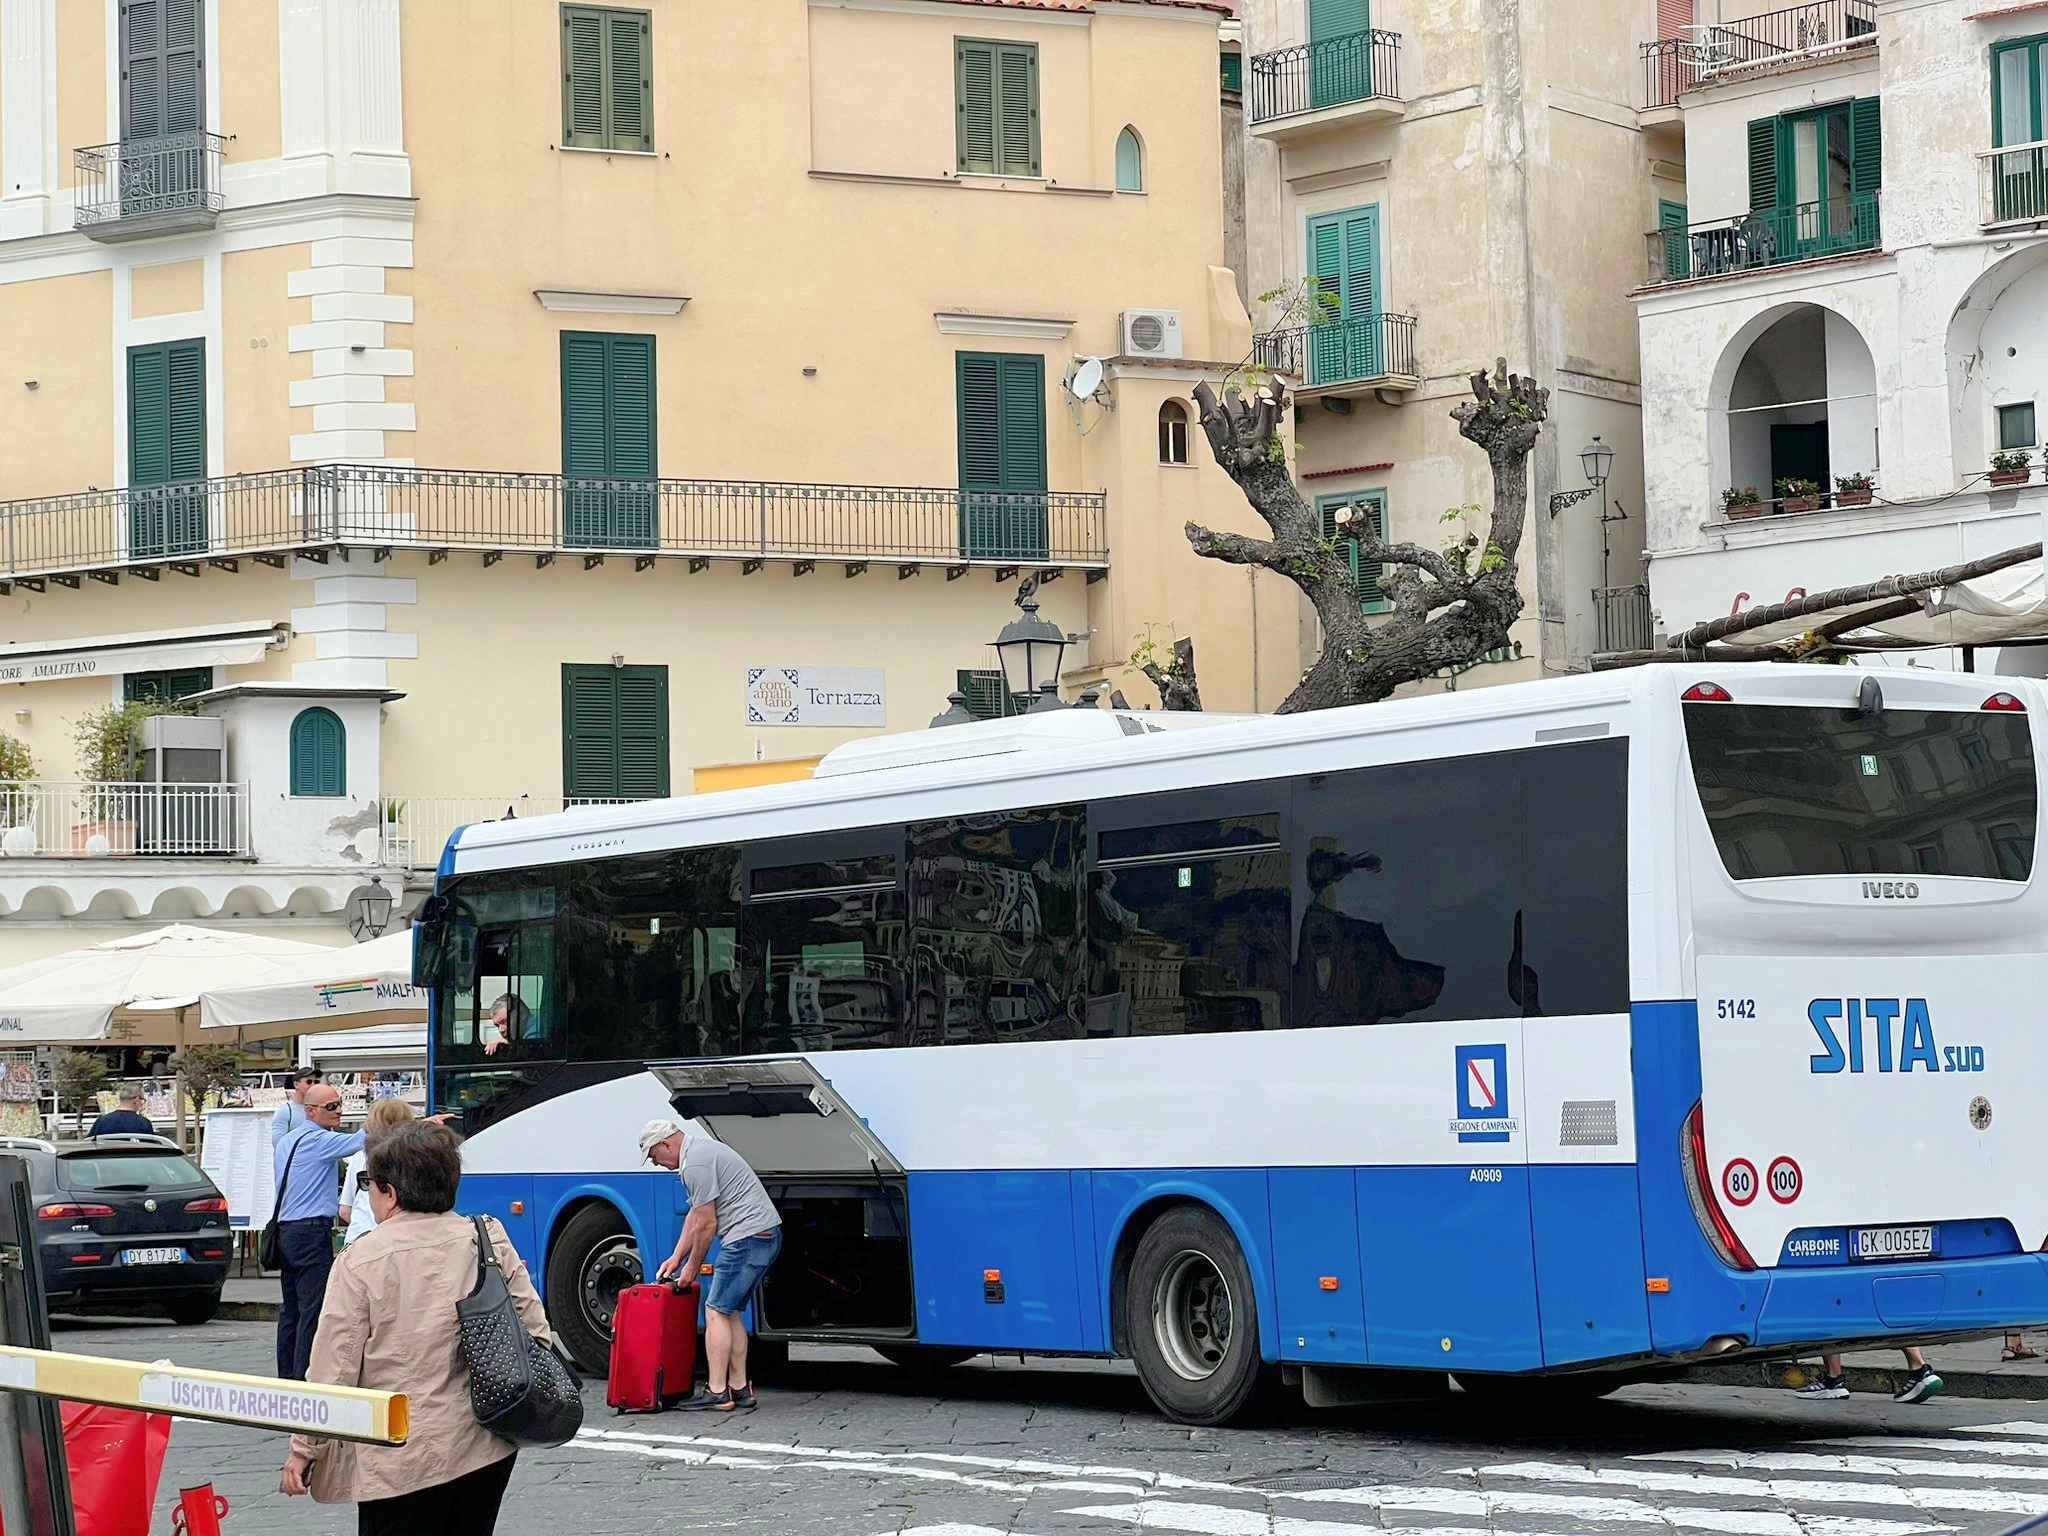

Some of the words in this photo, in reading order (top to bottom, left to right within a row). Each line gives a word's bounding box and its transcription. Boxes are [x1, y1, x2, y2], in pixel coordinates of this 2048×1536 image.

[32, 660, 96, 677] AMALFITANO
[805, 687, 881, 705] Terrazza
[1862, 882, 1920, 898] IVECO
[1717, 999, 1756, 1019] 5142
[1807, 998, 1940, 1073] SITA
[1943, 1046, 1985, 1072] SUD
[1449, 1121, 1480, 1132] REGIONE
[1481, 1120, 1517, 1131] CAMPANIA
[1469, 1168, 1502, 1182] A0909
[1732, 1172, 1749, 1192] 80
[1773, 1170, 1797, 1190] 100
[1788, 1239, 1840, 1251] CARBONE
[129, 1249, 142, 1262] DY
[147, 1248, 180, 1261] 817JG
[172, 1381, 225, 1411] USCITA
[229, 1389, 329, 1425] PARCHEGGIO
